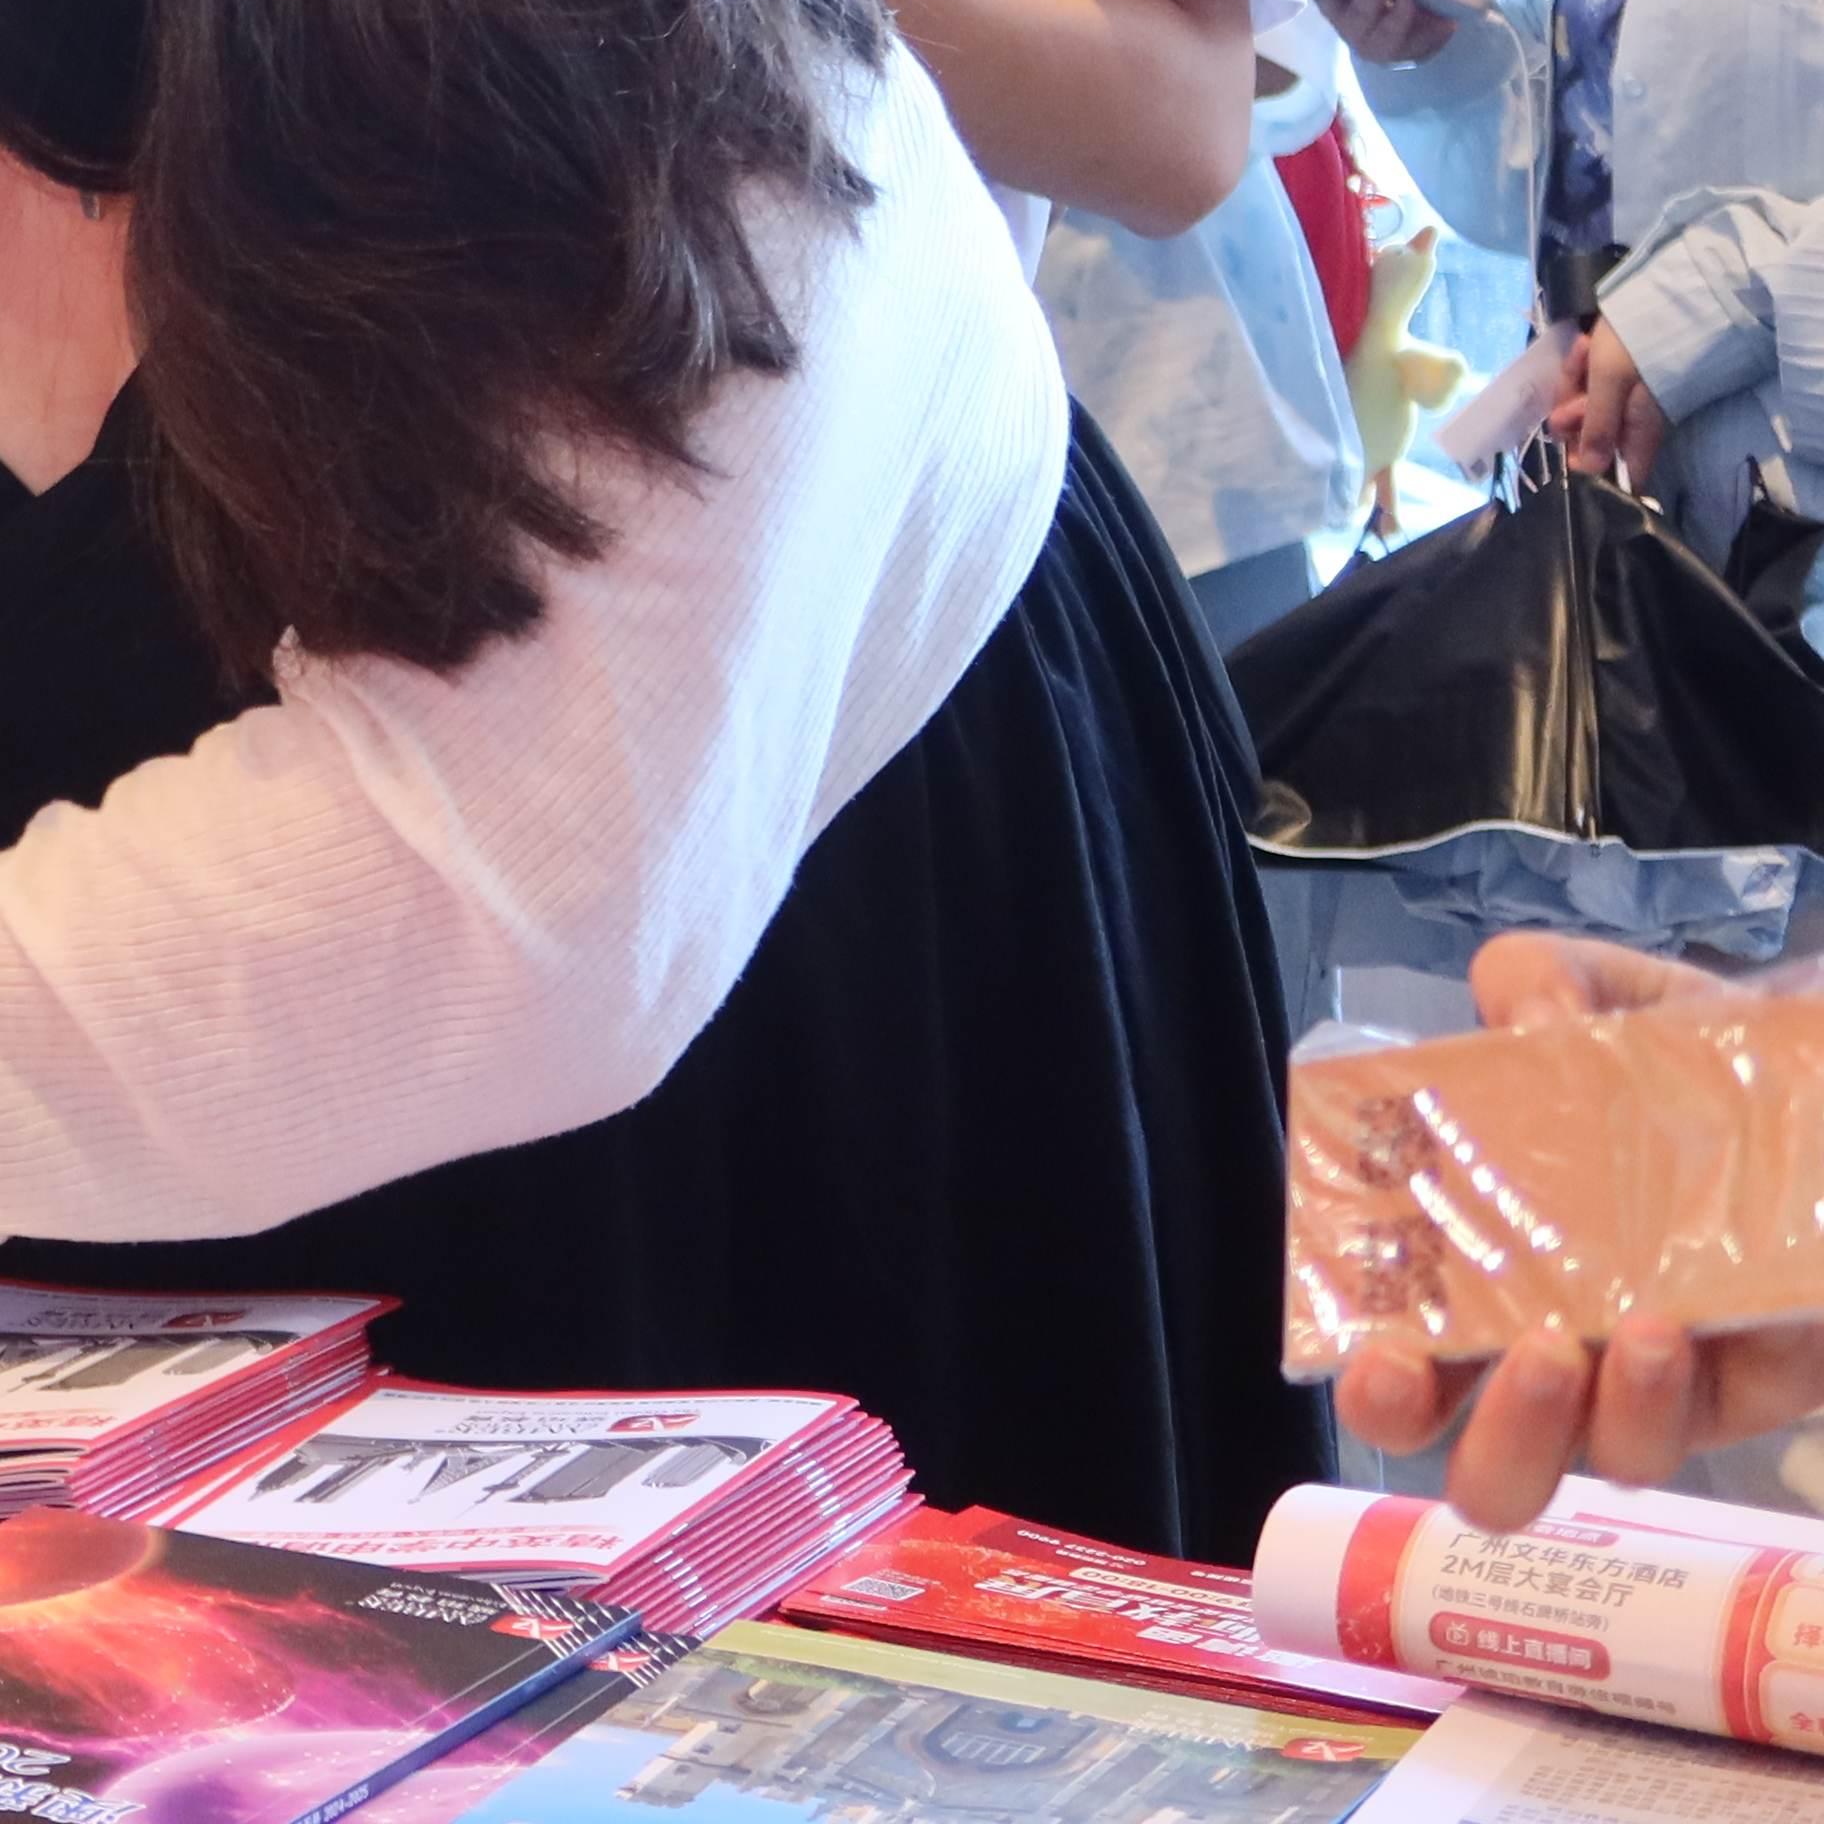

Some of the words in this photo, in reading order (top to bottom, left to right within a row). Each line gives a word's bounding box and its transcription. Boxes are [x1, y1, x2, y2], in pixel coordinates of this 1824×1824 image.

[1441, 1554, 1635, 1608] 2M层大宴会厅
[1449, 1531, 1690, 1590] 广州文华东方酒店
[1477, 1626, 1593, 1671] 线上直播间
